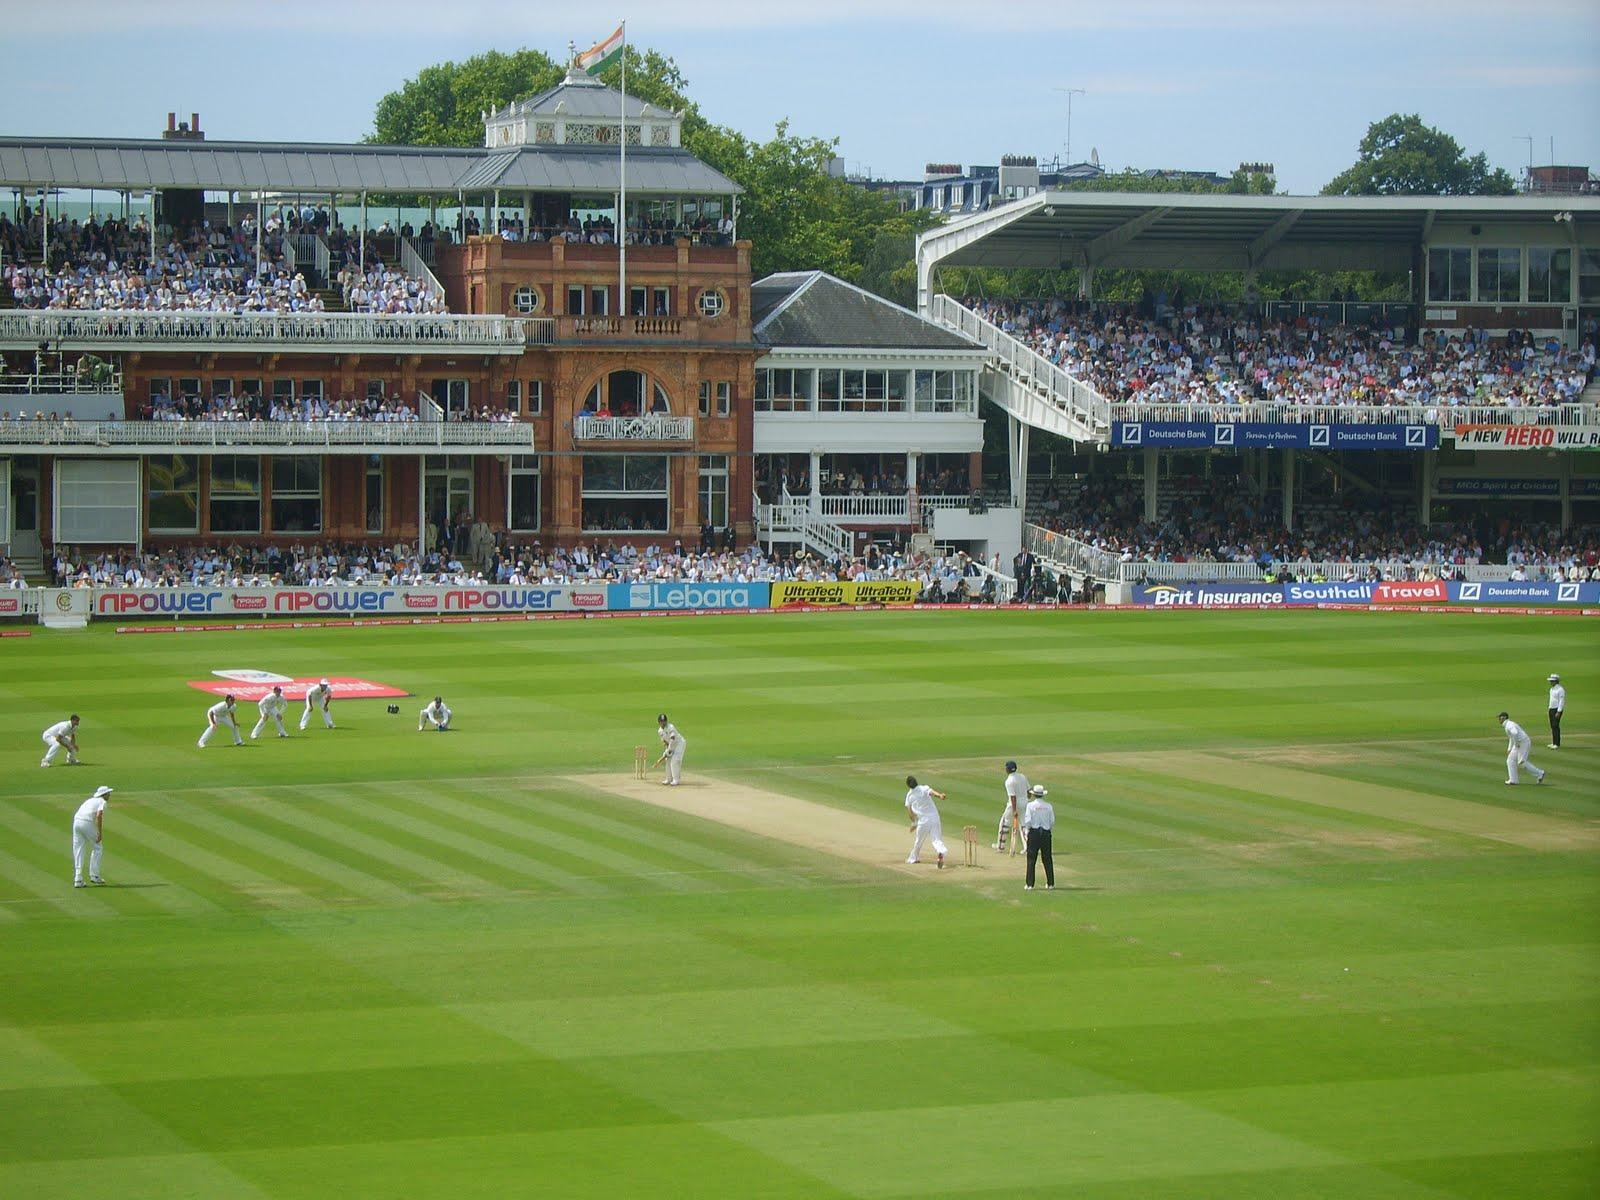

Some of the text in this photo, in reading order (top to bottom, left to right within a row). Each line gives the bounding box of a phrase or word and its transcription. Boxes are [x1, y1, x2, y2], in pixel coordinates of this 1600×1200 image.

[1149, 430, 1207, 439] Deutsche Bank
[1337, 431, 1398, 440] Deutsche Bank
[1461, 431, 1471, 442] A
[1474, 431, 1502, 443] NEW
[1504, 426, 1555, 446] HERO
[1557, 432, 1586, 444] WILL
[654, 584, 749, 608] Lebara
[784, 586, 844, 596] UltraTech
[856, 586, 912, 596] UltraTech
[1290, 585, 1441, 599] Southall Travel
[1488, 587, 1550, 597] Deutsche Bank
[1155, 589, 1283, 606] Brit Insurance
